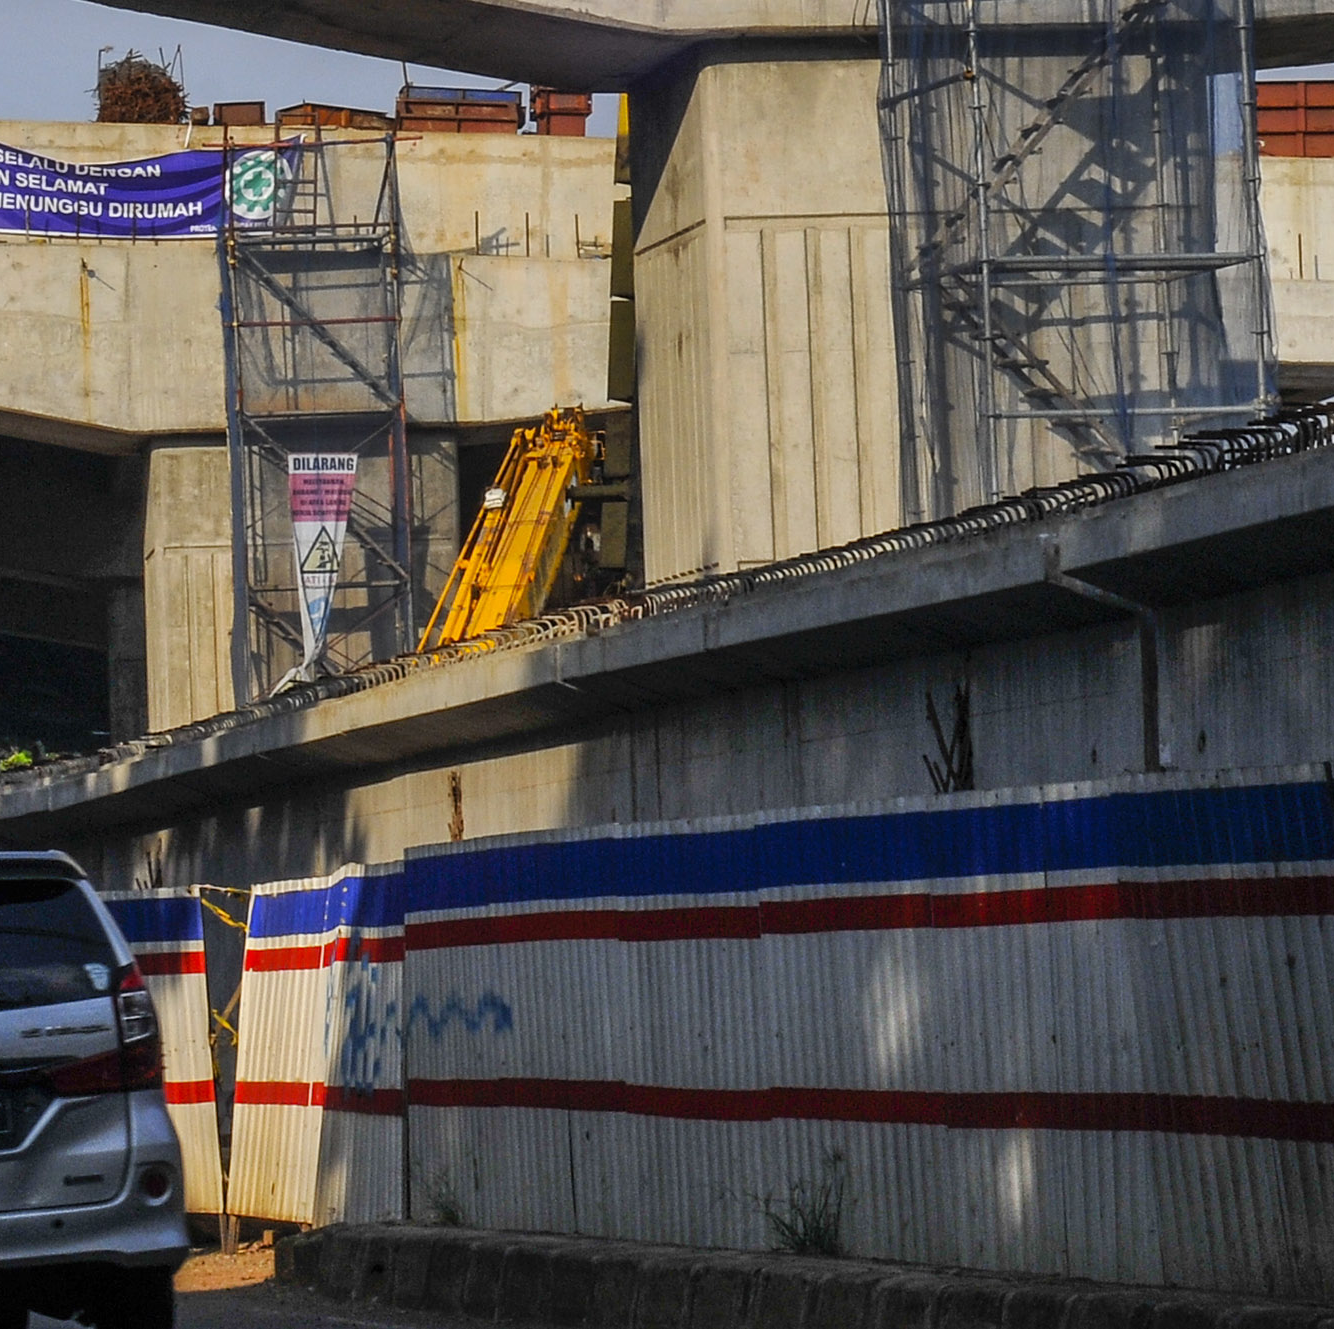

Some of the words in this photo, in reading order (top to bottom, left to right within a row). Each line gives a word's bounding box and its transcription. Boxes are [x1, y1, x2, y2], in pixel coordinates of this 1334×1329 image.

[75, 162, 162, 178] DENGAN
[15, 173, 109, 196] SELAMAT
[108, 201, 203, 219] DIRUMAH
[293, 457, 354, 471] DILARANG
